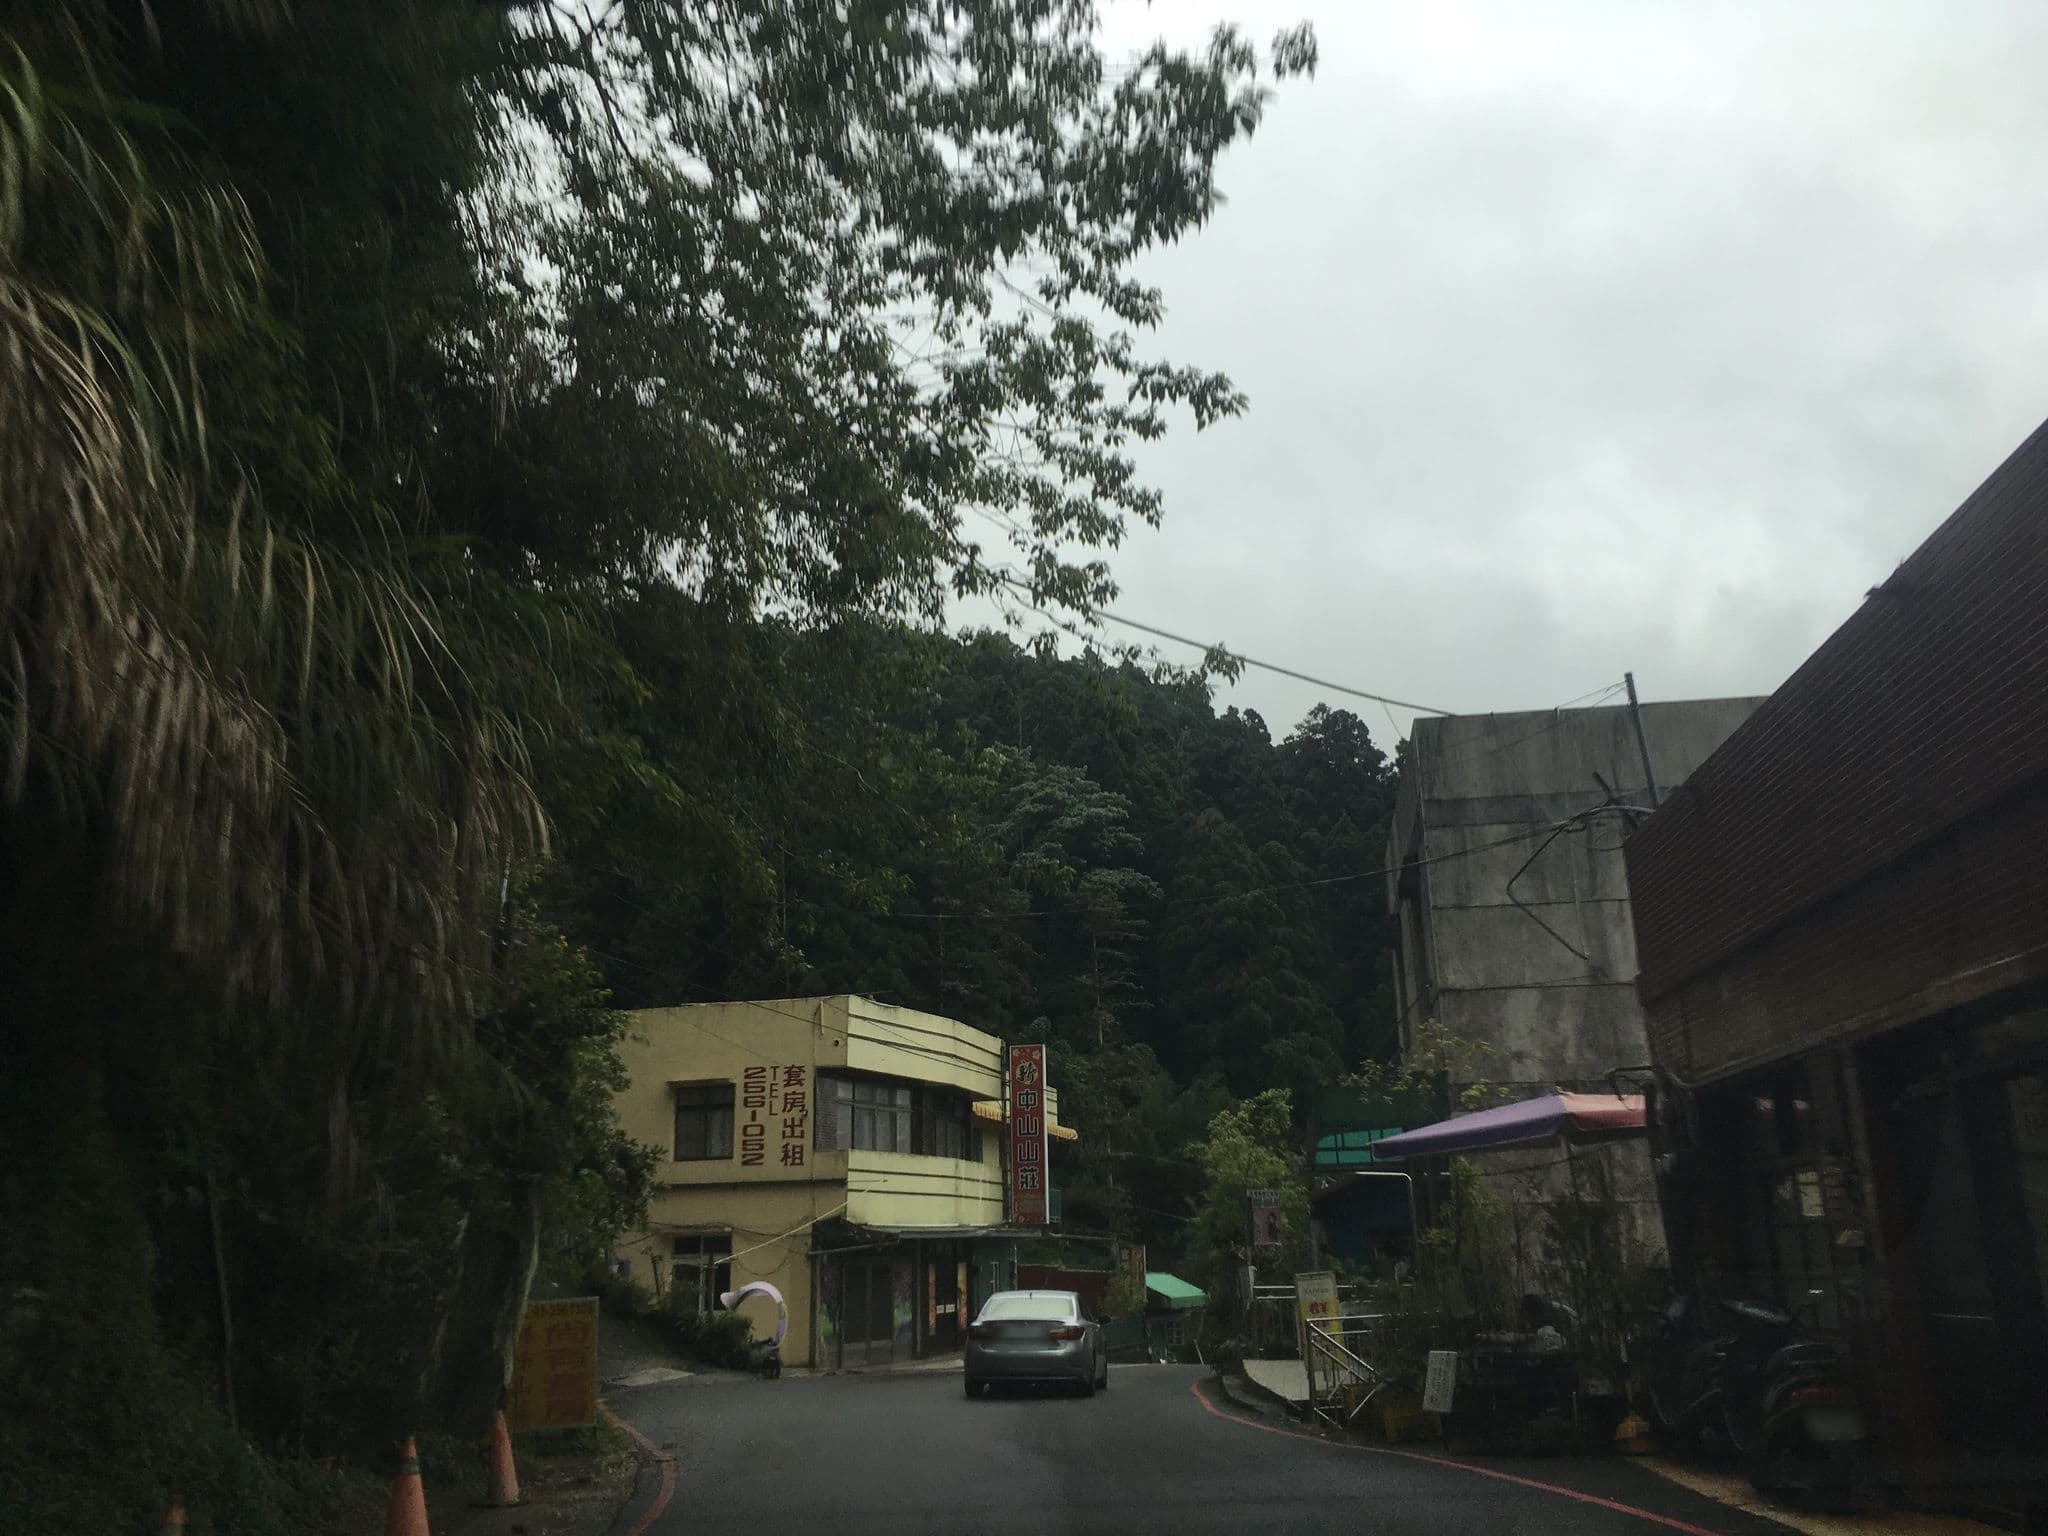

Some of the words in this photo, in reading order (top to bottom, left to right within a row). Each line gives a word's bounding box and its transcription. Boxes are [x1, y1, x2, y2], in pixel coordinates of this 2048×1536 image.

[769, 1066, 781, 1116] TEL
[780, 1064, 806, 1166] 套房出租
[1016, 1060, 1040, 1190] 新中山山莊
